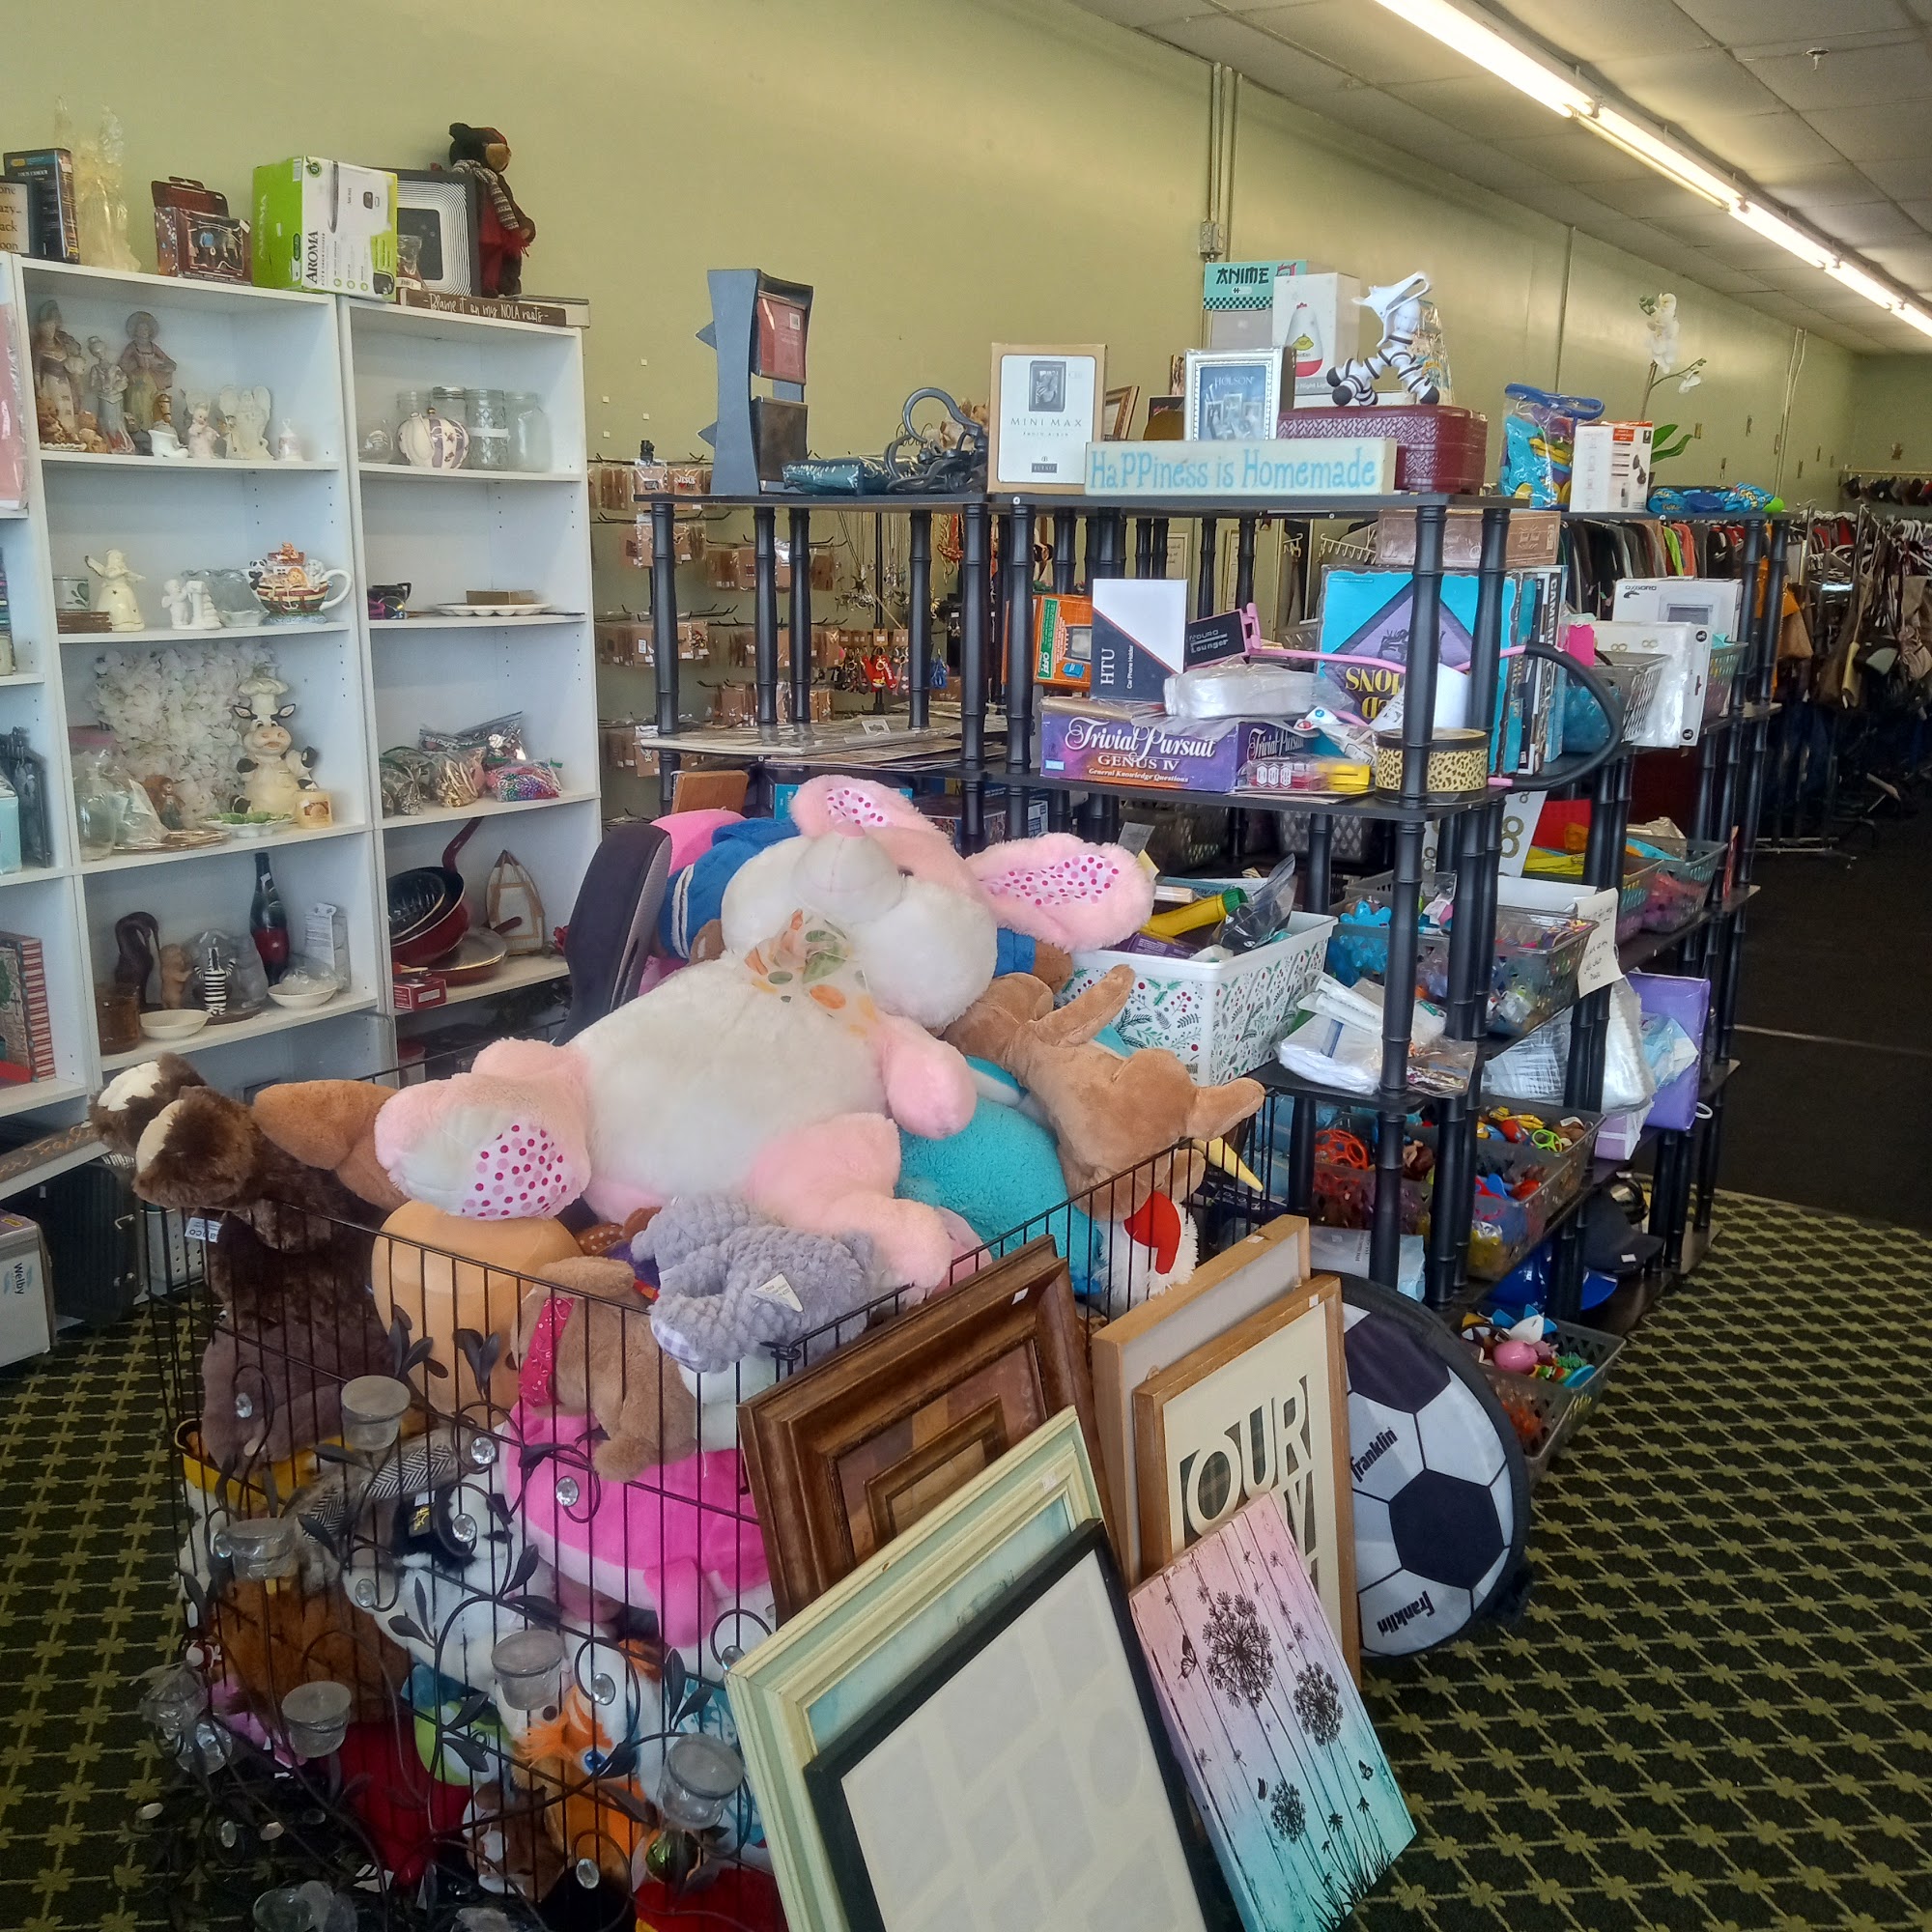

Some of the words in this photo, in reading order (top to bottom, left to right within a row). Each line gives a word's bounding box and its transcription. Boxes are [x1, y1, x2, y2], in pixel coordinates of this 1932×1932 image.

[0, 185, 15, 195] one
[0, 220, 17, 232] ack
[0, 242, 18, 250] oon
[305, 230, 319, 284] AROMA
[1215, 267, 1269, 285] ANIME
[500, 304, 521, 320] NOLA
[1214, 376, 1252, 385] HOLSON
[1010, 417, 1044, 426] MINI
[1050, 418, 1082, 427] MAX
[1216, 456, 1235, 489] is
[1243, 446, 1377, 489] Homemade
[1191, 639, 1229, 654] Lounger
[1100, 648, 1115, 685] HTU
[1065, 716, 1140, 752] Trivial
[1129, 724, 1216, 763] Pursuit
[1247, 727, 1276, 761] Trivial
[1097, 755, 1157, 770] GENUS
[1162, 759, 1180, 772] IV
[1089, 768, 1115, 777] General
[1116, 770, 1153, 781] Knowledge
[1153, 774, 1189, 783] Questions
[14, 1262, 25, 1295] Welby
[1187, 1378, 1312, 1536] OUR
[1350, 1428, 1399, 1483] franklin
[1377, 1590, 1435, 1636] franklin
